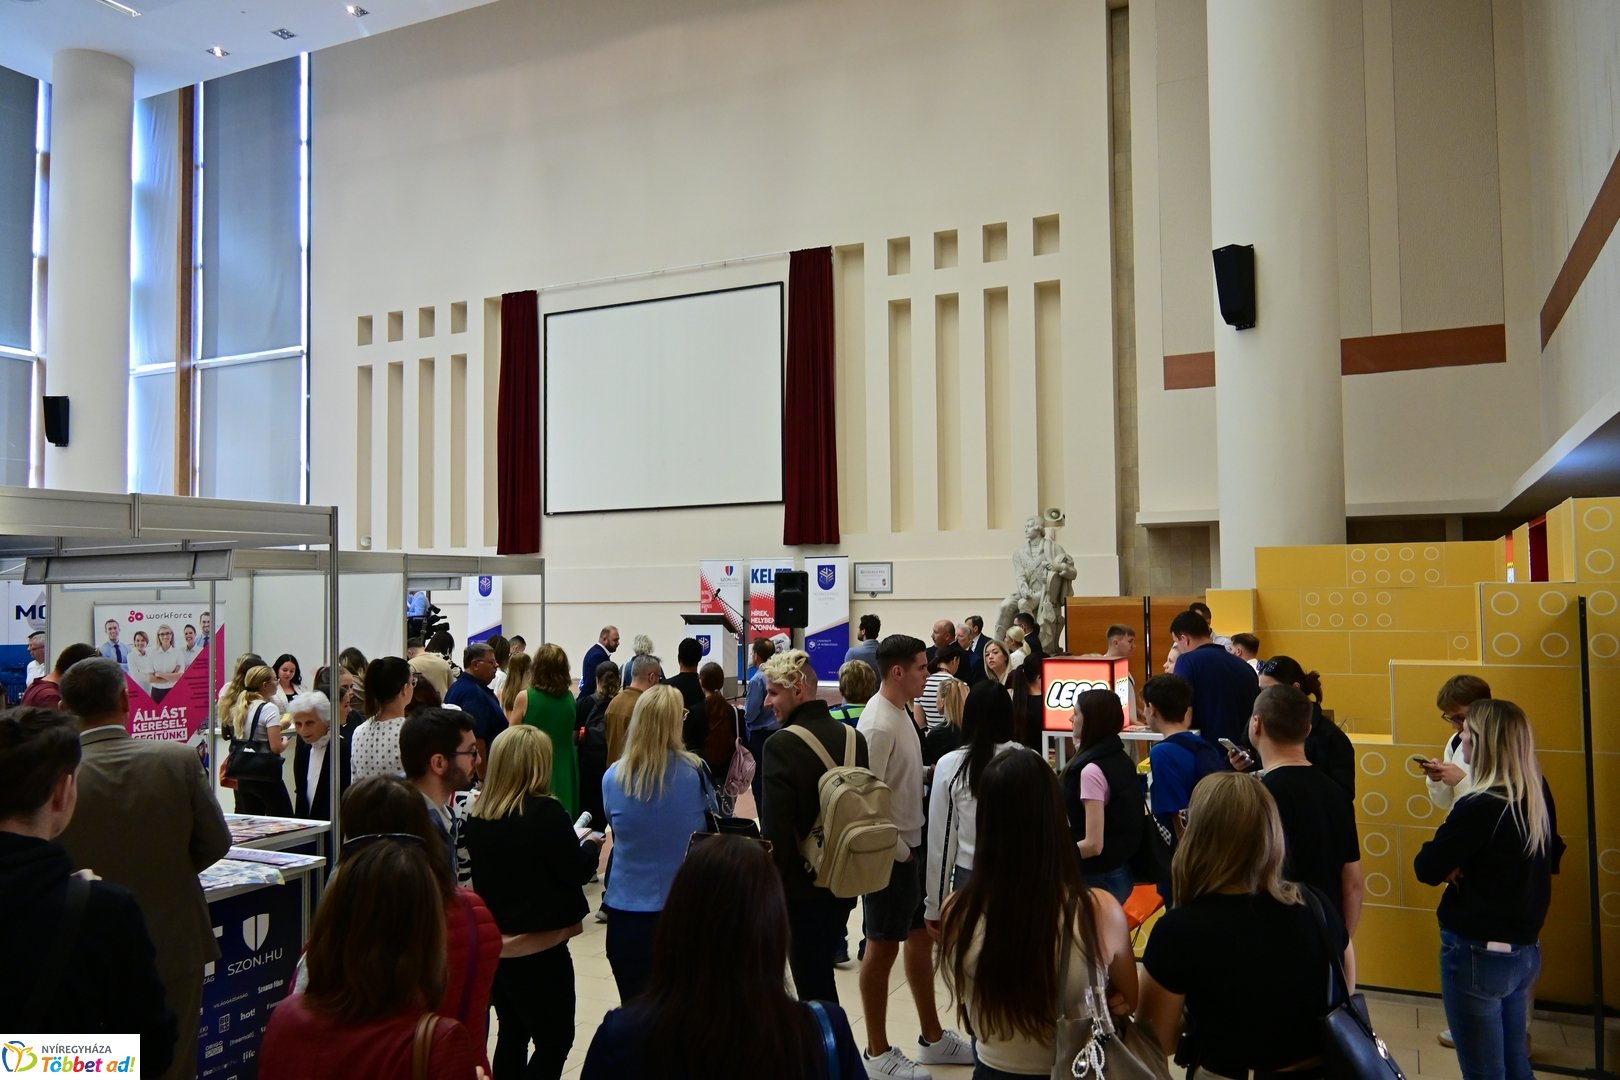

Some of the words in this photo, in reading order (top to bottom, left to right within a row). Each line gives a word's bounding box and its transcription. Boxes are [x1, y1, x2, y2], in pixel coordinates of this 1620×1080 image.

[145, 612, 193, 620] workforce
[132, 705, 187, 722] ÁLLÁST
[132, 718, 187, 732] KERESEL?
[227, 948, 283, 976] SZON.HU
